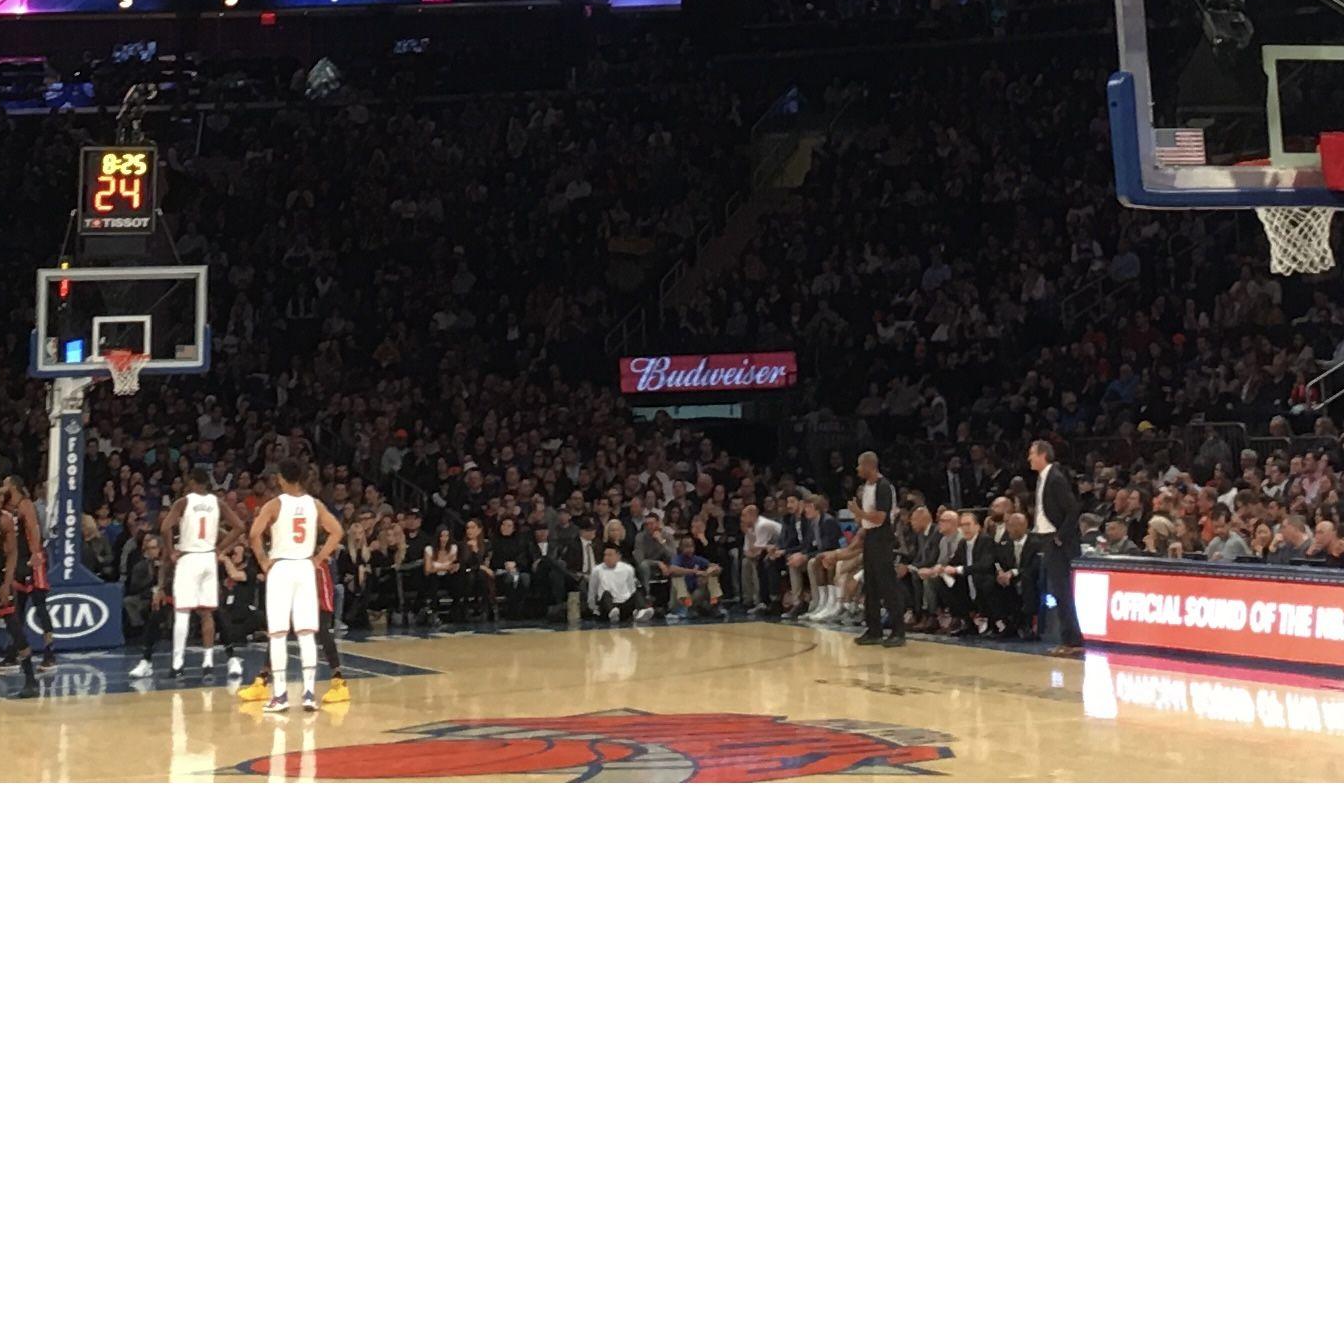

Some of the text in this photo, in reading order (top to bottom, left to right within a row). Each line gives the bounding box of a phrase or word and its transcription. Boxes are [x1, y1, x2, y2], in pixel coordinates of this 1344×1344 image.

[102, 153, 147, 175] 8:25
[94, 175, 140, 211] 24
[102, 217, 151, 228] TISSOT
[630, 356, 787, 392] Budweiser
[198, 516, 206, 539] 1
[292, 517, 306, 543] 5
[48, 603, 95, 628] KIA
[1111, 590, 1183, 625] OFFICIAL
[1183, 595, 1247, 631] SOUND
[1248, 600, 1277, 634] OF
[1278, 603, 1313, 638] THE
